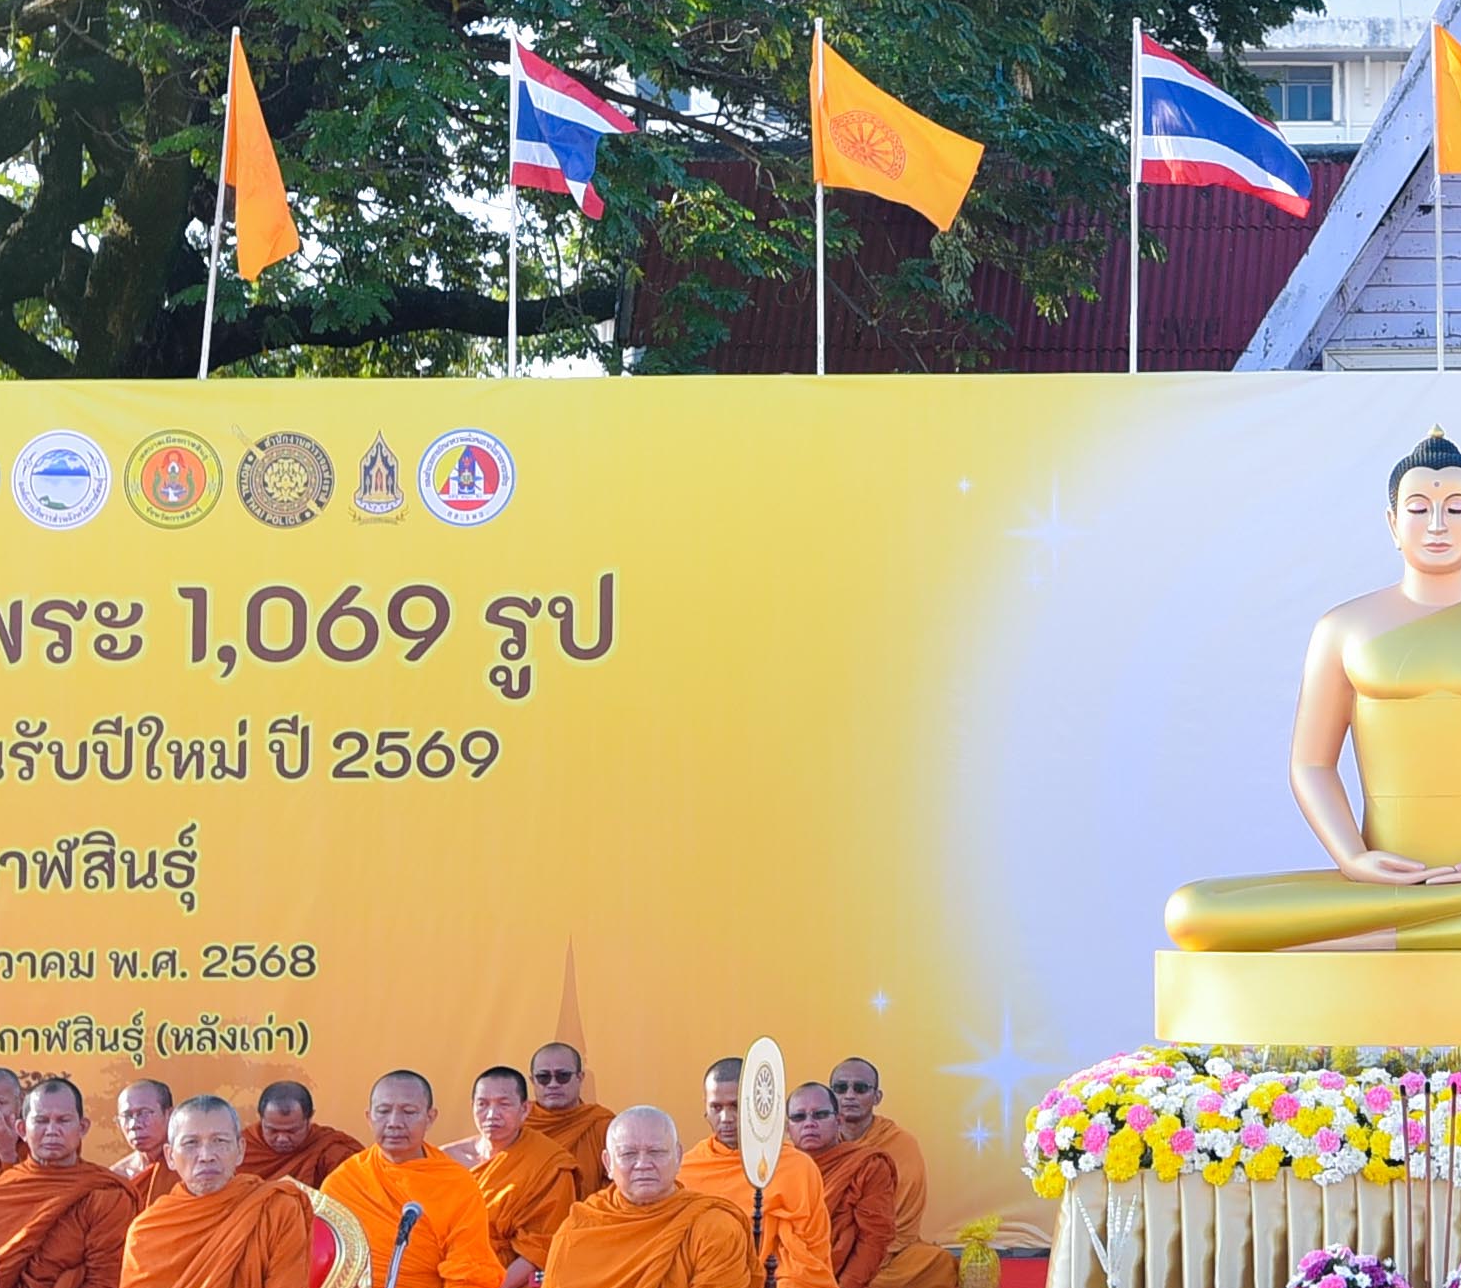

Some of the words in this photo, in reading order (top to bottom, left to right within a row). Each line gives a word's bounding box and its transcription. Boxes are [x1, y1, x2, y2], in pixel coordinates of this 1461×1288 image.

[265, 512, 304, 526] POLICE
[177, 584, 451, 678] 1,069
[485, 573, 614, 700] รูป
[268, 714, 310, 780] ปี
[332, 730, 500, 779] 2569
[108, 949, 187, 979] พ.ศ.
[202, 944, 316, 978] 2568
[157, 1015, 309, 1056] (หลังเก่า)
